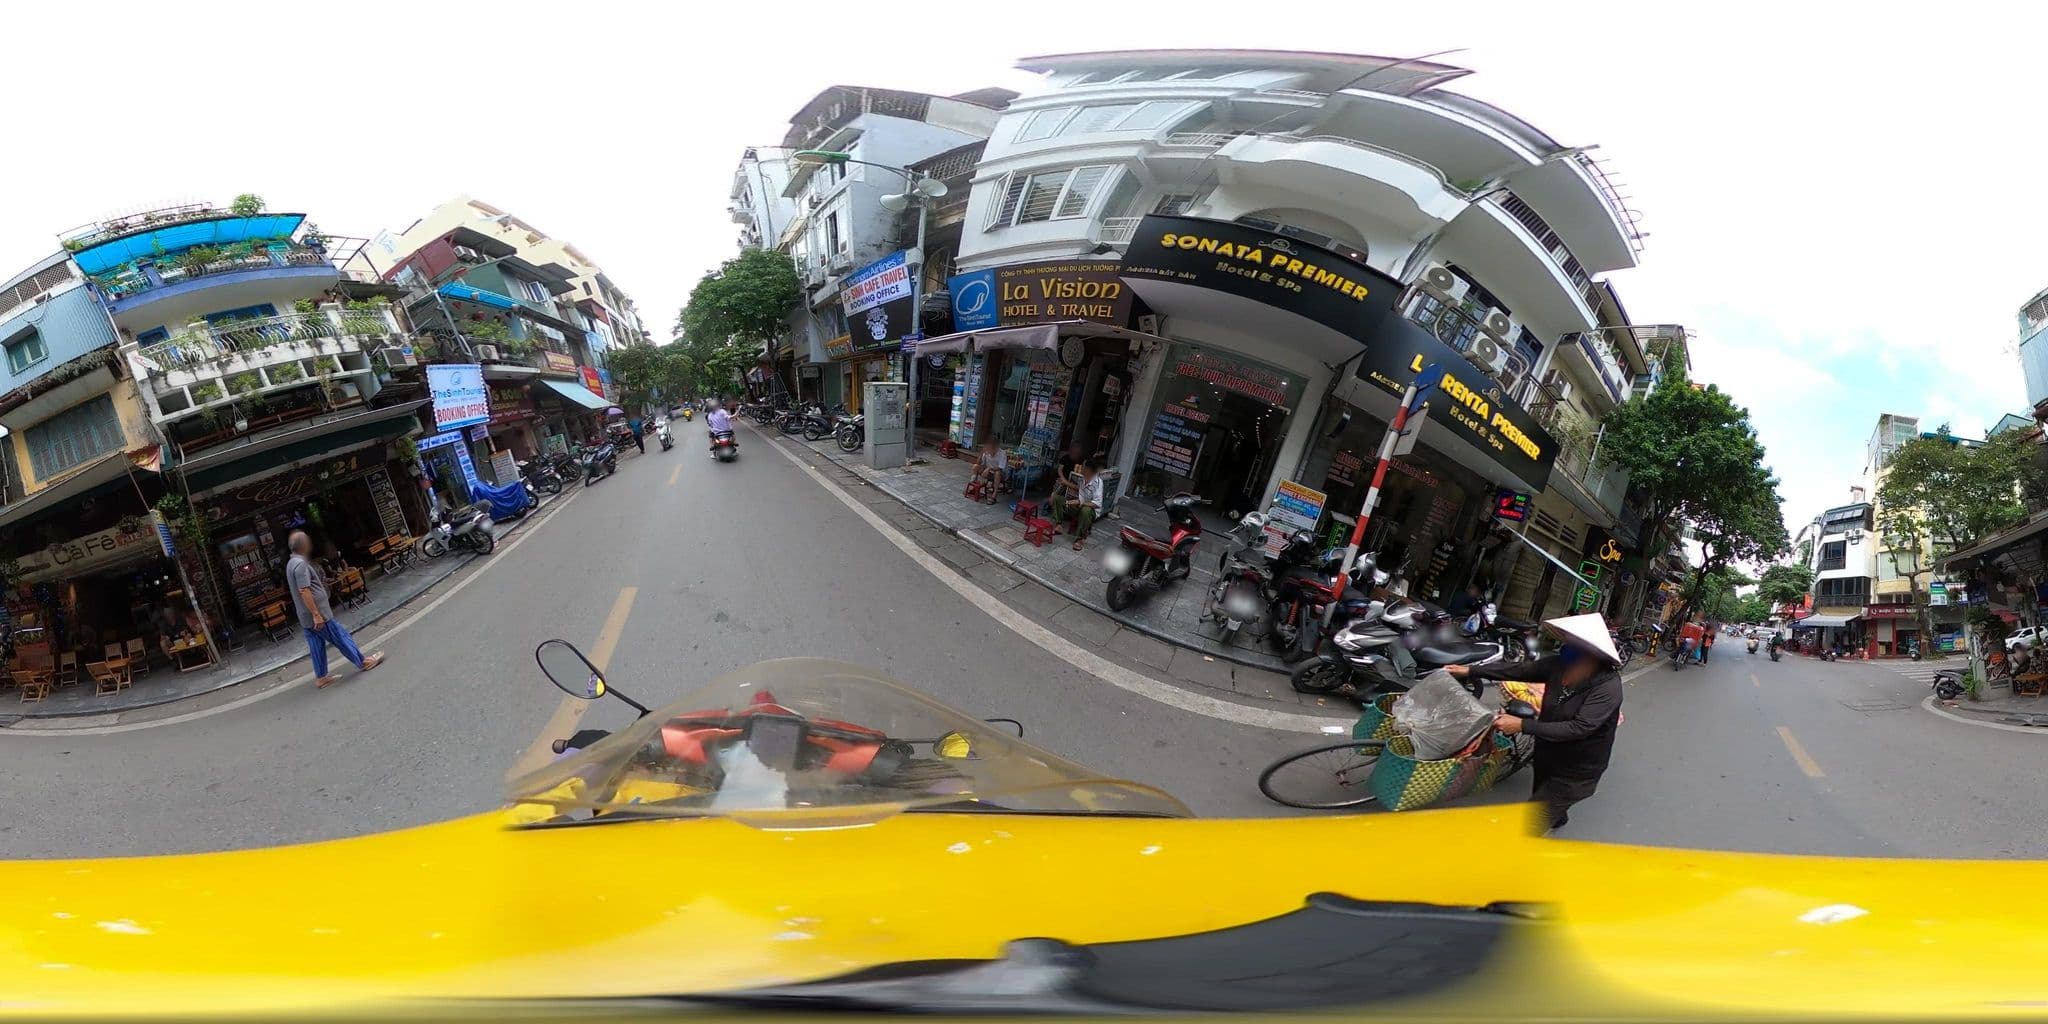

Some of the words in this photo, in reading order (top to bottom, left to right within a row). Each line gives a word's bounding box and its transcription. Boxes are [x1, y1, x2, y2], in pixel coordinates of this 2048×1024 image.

[864, 277, 881, 294] CAFE
[880, 267, 908, 288] TRAVEL
[1161, 233, 1263, 265] SONATA
[1270, 253, 1370, 302] PREMIER
[1216, 261, 1258, 279] Hotel
[1258, 271, 1273, 283] &
[1276, 276, 1302, 293] Spa
[850, 294, 876, 310] BOOKING
[876, 285, 900, 300] OFFICE
[1003, 282, 1029, 301] La
[1041, 276, 1121, 300] Vision
[1003, 304, 1039, 317] HOTEL
[1047, 305, 1056, 316] &
[1062, 304, 1113, 318] TRAVEL
[437, 406, 466, 424] BOOKING
[467, 402, 487, 418] OFFICE
[1450, 405, 1478, 432] Hotel
[1488, 435, 1504, 452] Spa
[1490, 411, 1541, 461] PREMIER
[1600, 538, 1625, 563] Spa
